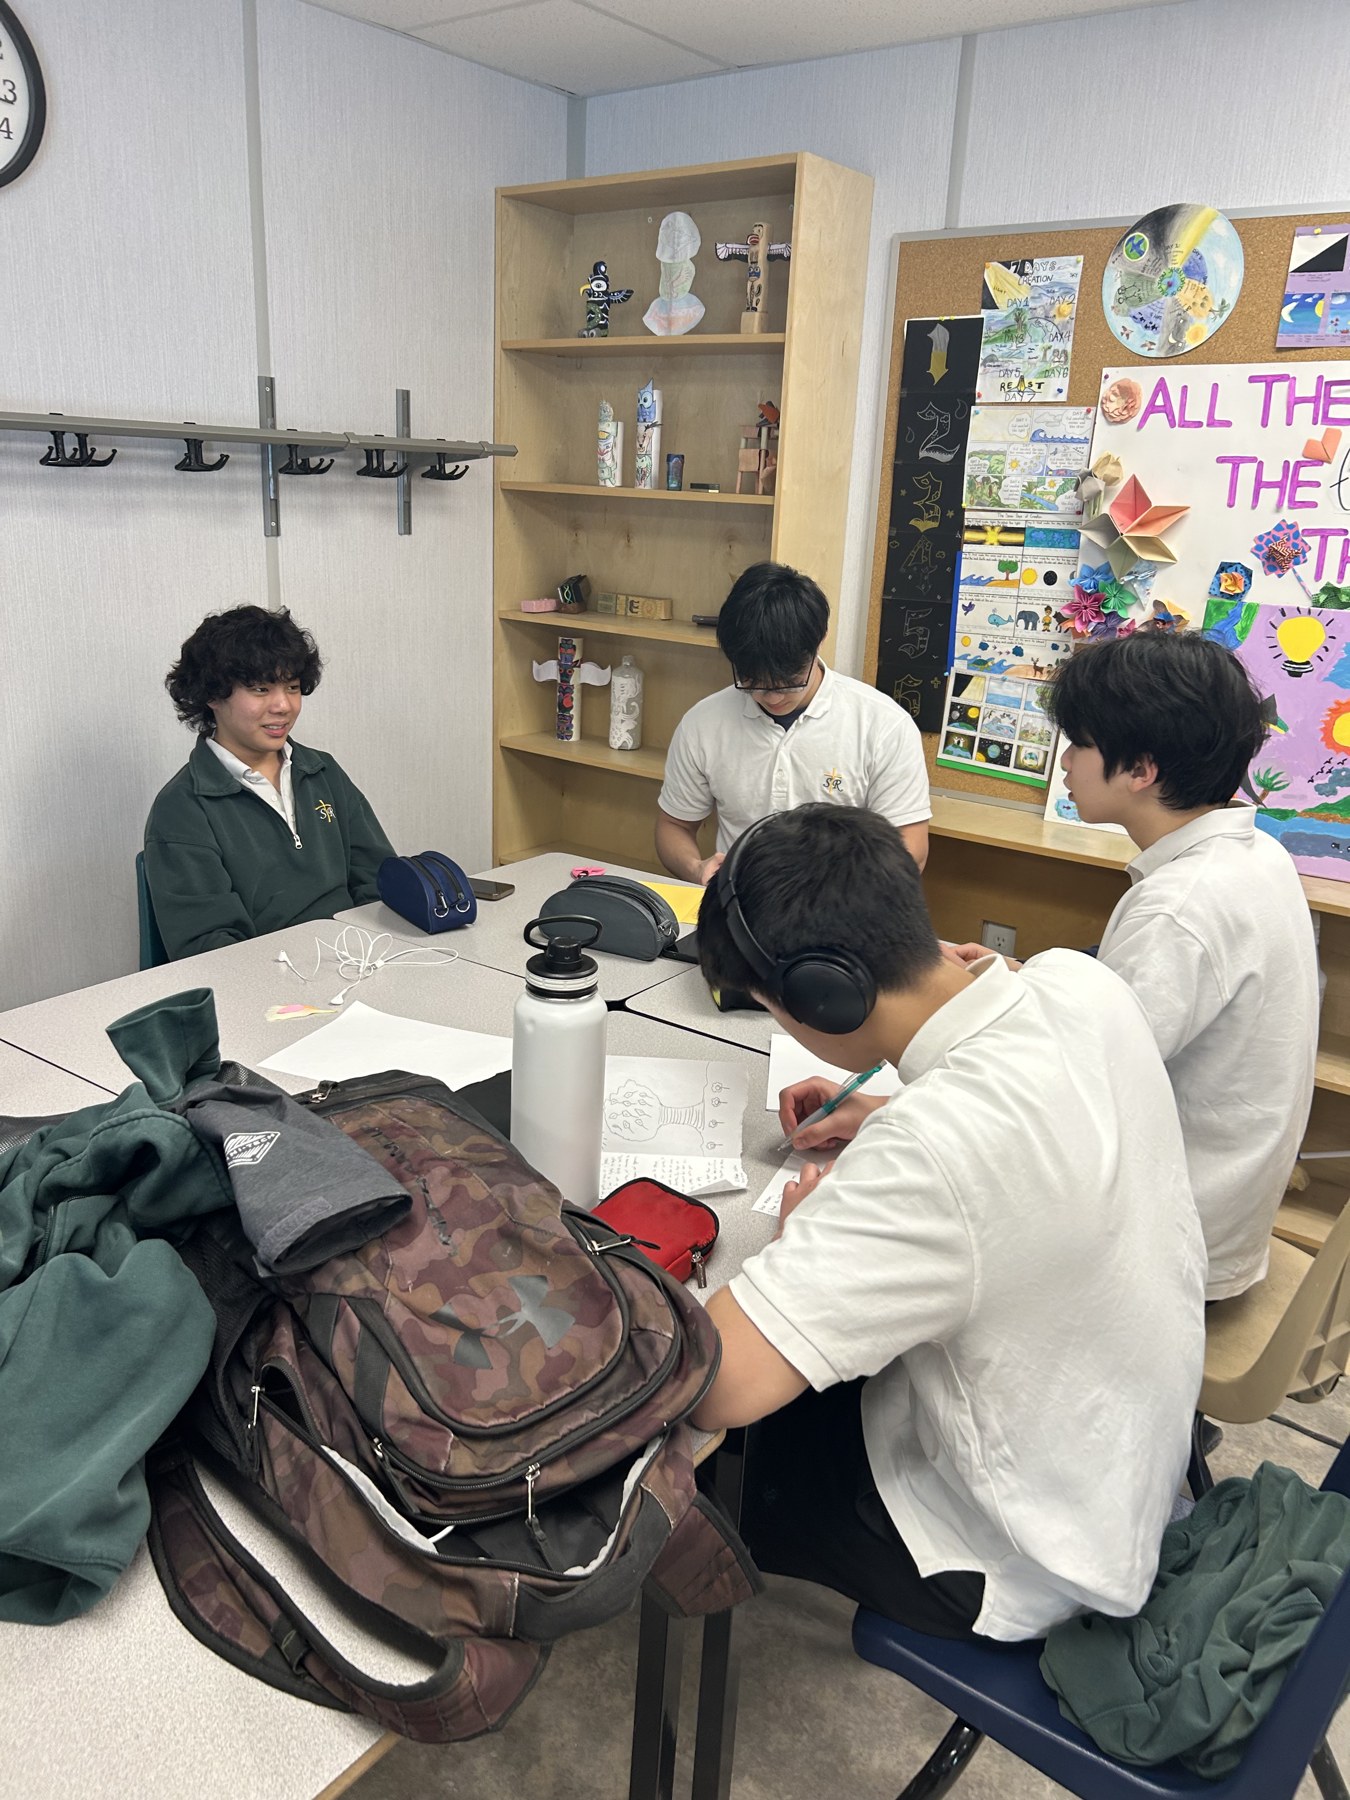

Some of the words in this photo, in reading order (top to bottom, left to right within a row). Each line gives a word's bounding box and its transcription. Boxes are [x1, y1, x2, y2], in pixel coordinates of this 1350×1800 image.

[3, 79, 17, 105] 3
[1018, 274, 1054, 286] CREATION
[1024, 261, 1057, 273] DAYS
[927, 323, 949, 386] 1
[1137, 376, 1233, 431] ALL
[917, 401, 960, 463] 2
[909, 471, 943, 533] 3
[1216, 455, 1324, 511] THE
[900, 535, 938, 595] 4
[629, 600, 640, 614] E
[898, 608, 934, 659] 5
